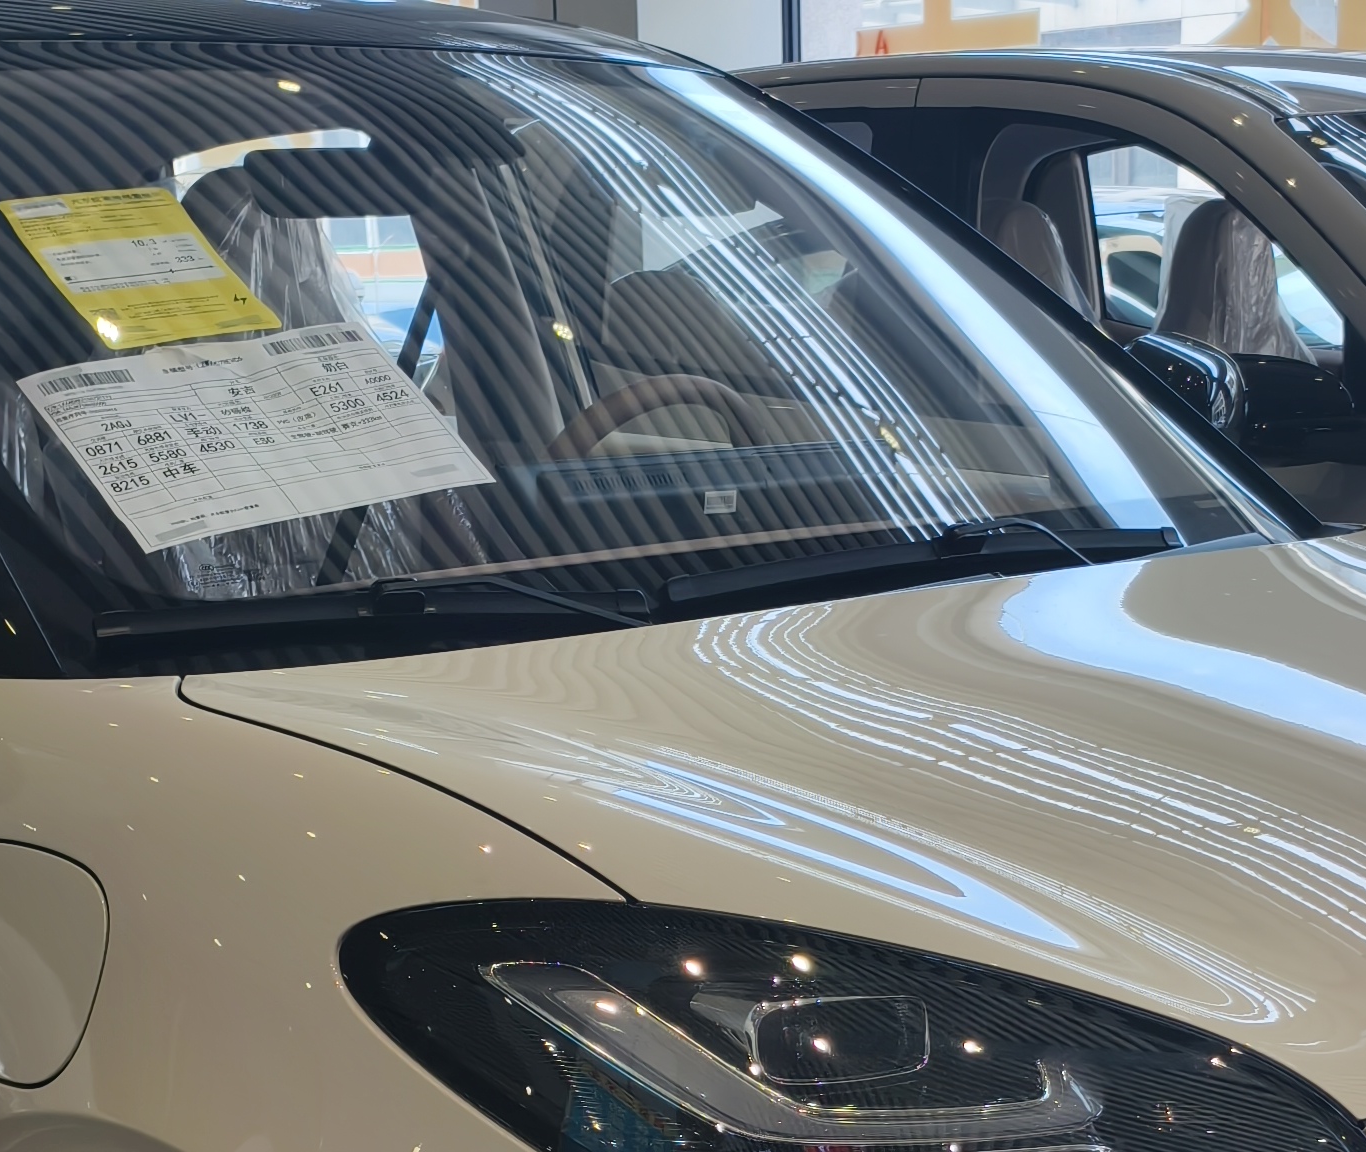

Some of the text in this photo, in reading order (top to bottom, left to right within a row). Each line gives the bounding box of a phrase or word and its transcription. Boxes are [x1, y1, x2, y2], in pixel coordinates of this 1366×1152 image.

[321, 361, 349, 373] 奶白
[227, 385, 256, 398] 安吉
[309, 381, 345, 397] E261
[376, 388, 409, 402] 4524
[330, 397, 366, 413] 5300
[185, 425, 223, 438] 手动
[232, 420, 269, 432] 1738
[137, 430, 173, 446] 6881
[85, 441, 123, 458] 0871
[199, 439, 236, 454] 4530
[149, 448, 187, 463] 5580
[98, 458, 138, 476] 2615
[162, 462, 200, 479] 中车
[110, 475, 150, 493] 8215
